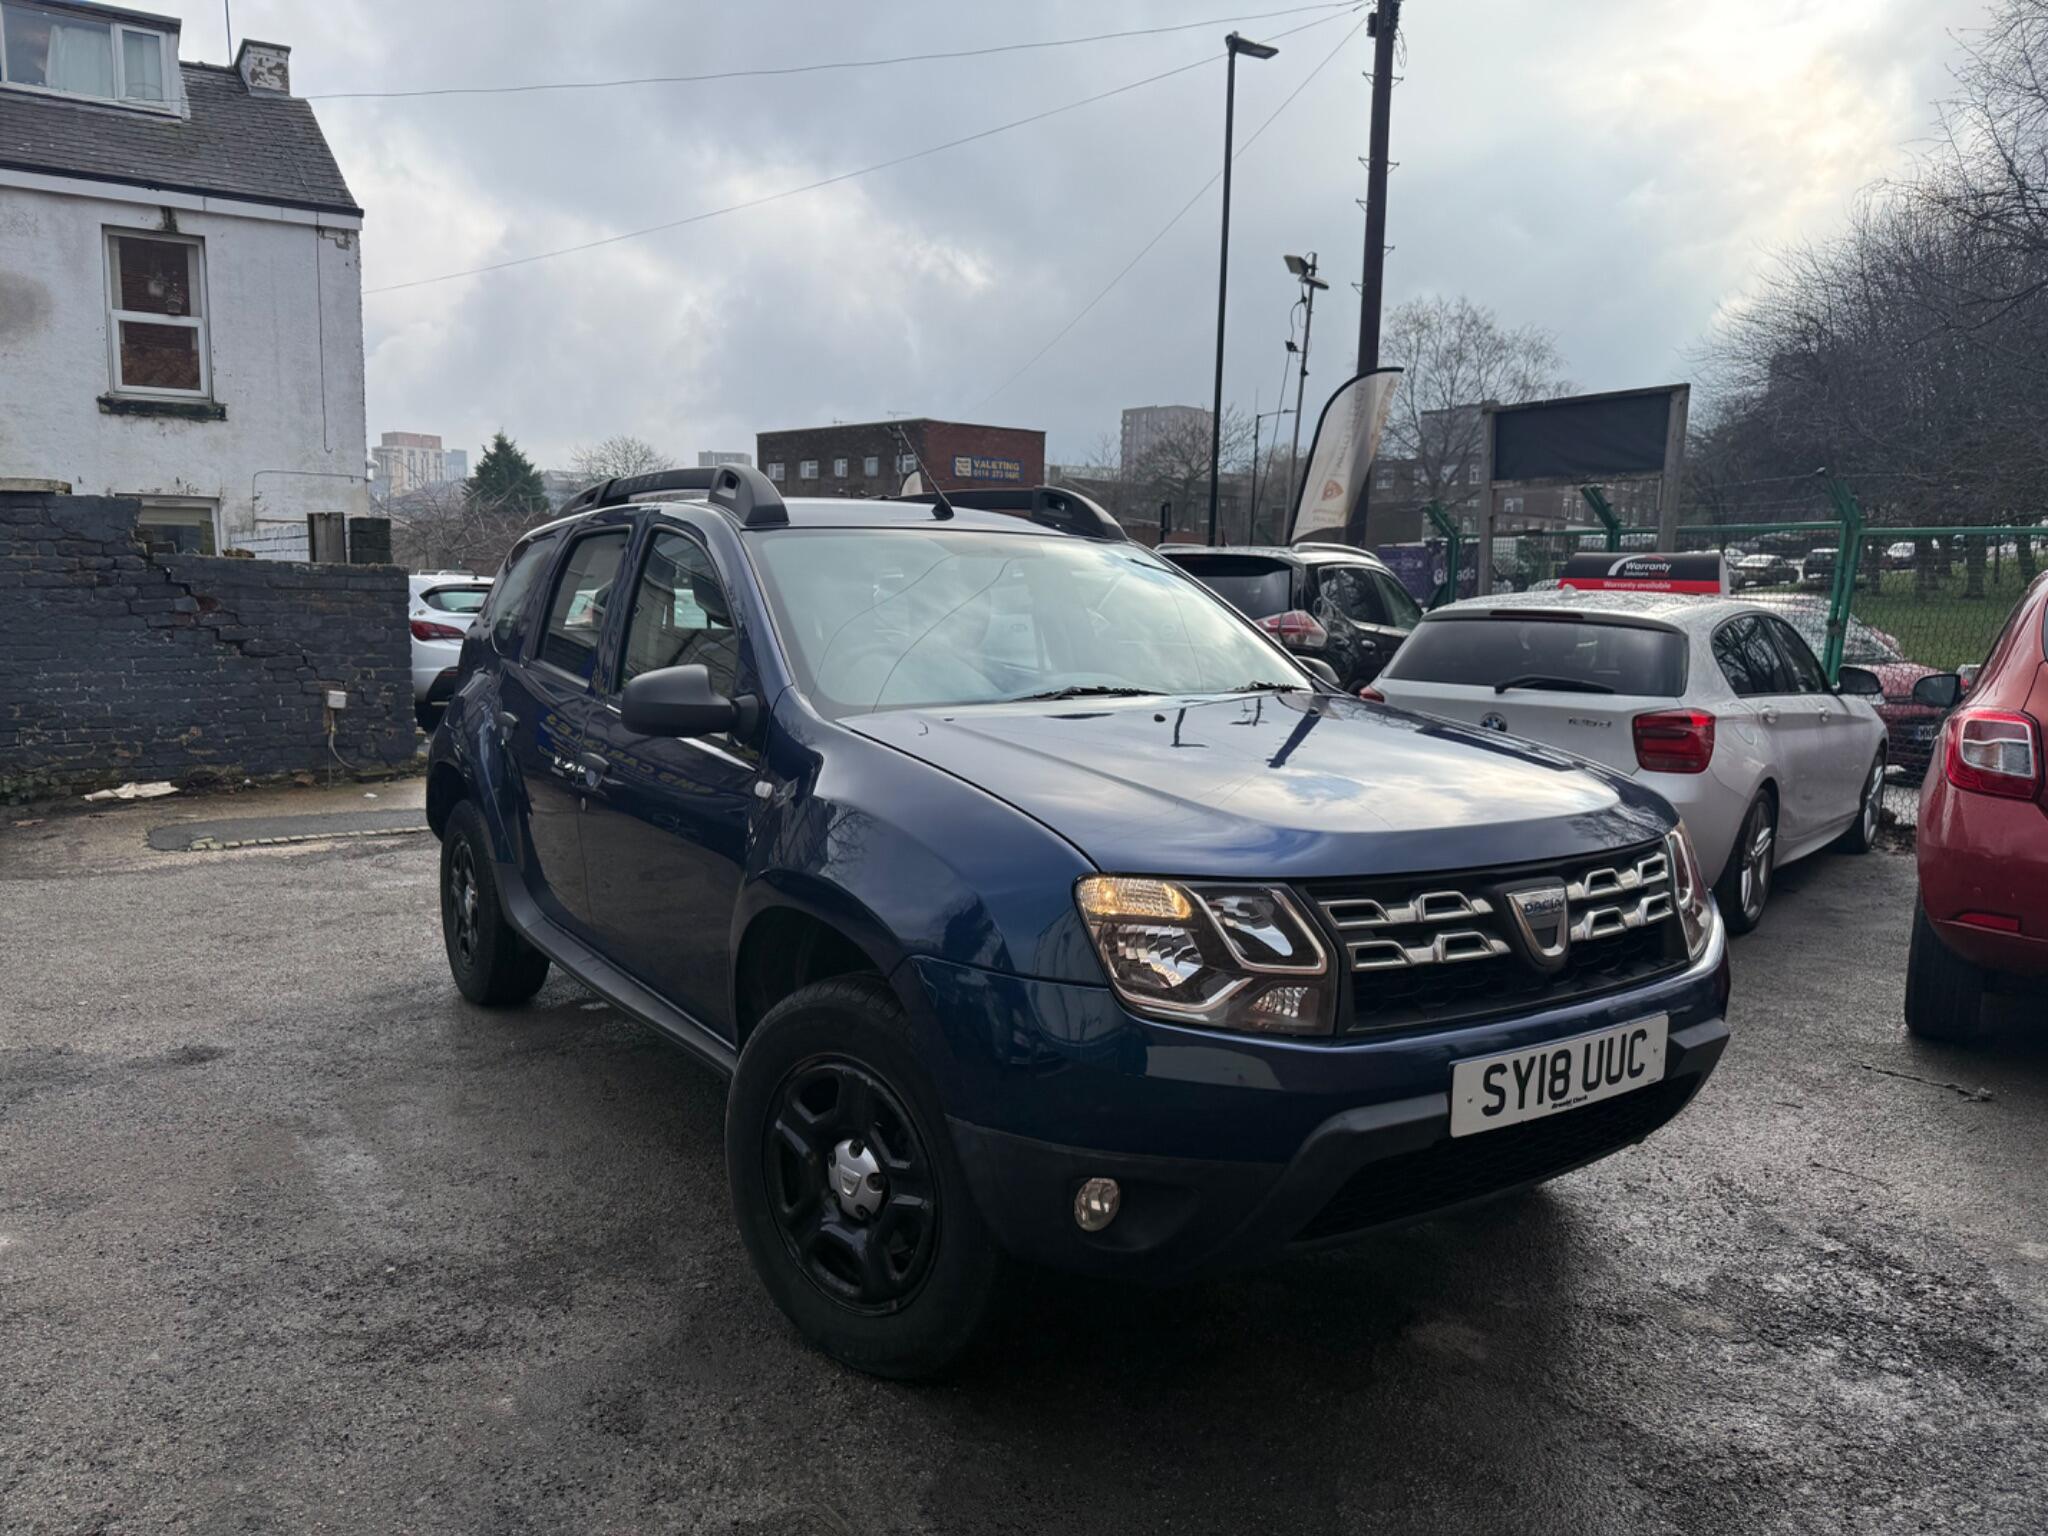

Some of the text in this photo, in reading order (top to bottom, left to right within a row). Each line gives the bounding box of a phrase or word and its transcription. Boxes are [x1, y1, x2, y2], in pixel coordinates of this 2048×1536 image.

[973, 460, 1020, 471] VALETING
[1625, 562, 1672, 574] Warranty
[1603, 581, 1635, 590] Warranty
[1525, 897, 1563, 913] DACIA
[1481, 1028, 1647, 1117] SY18 UUC
